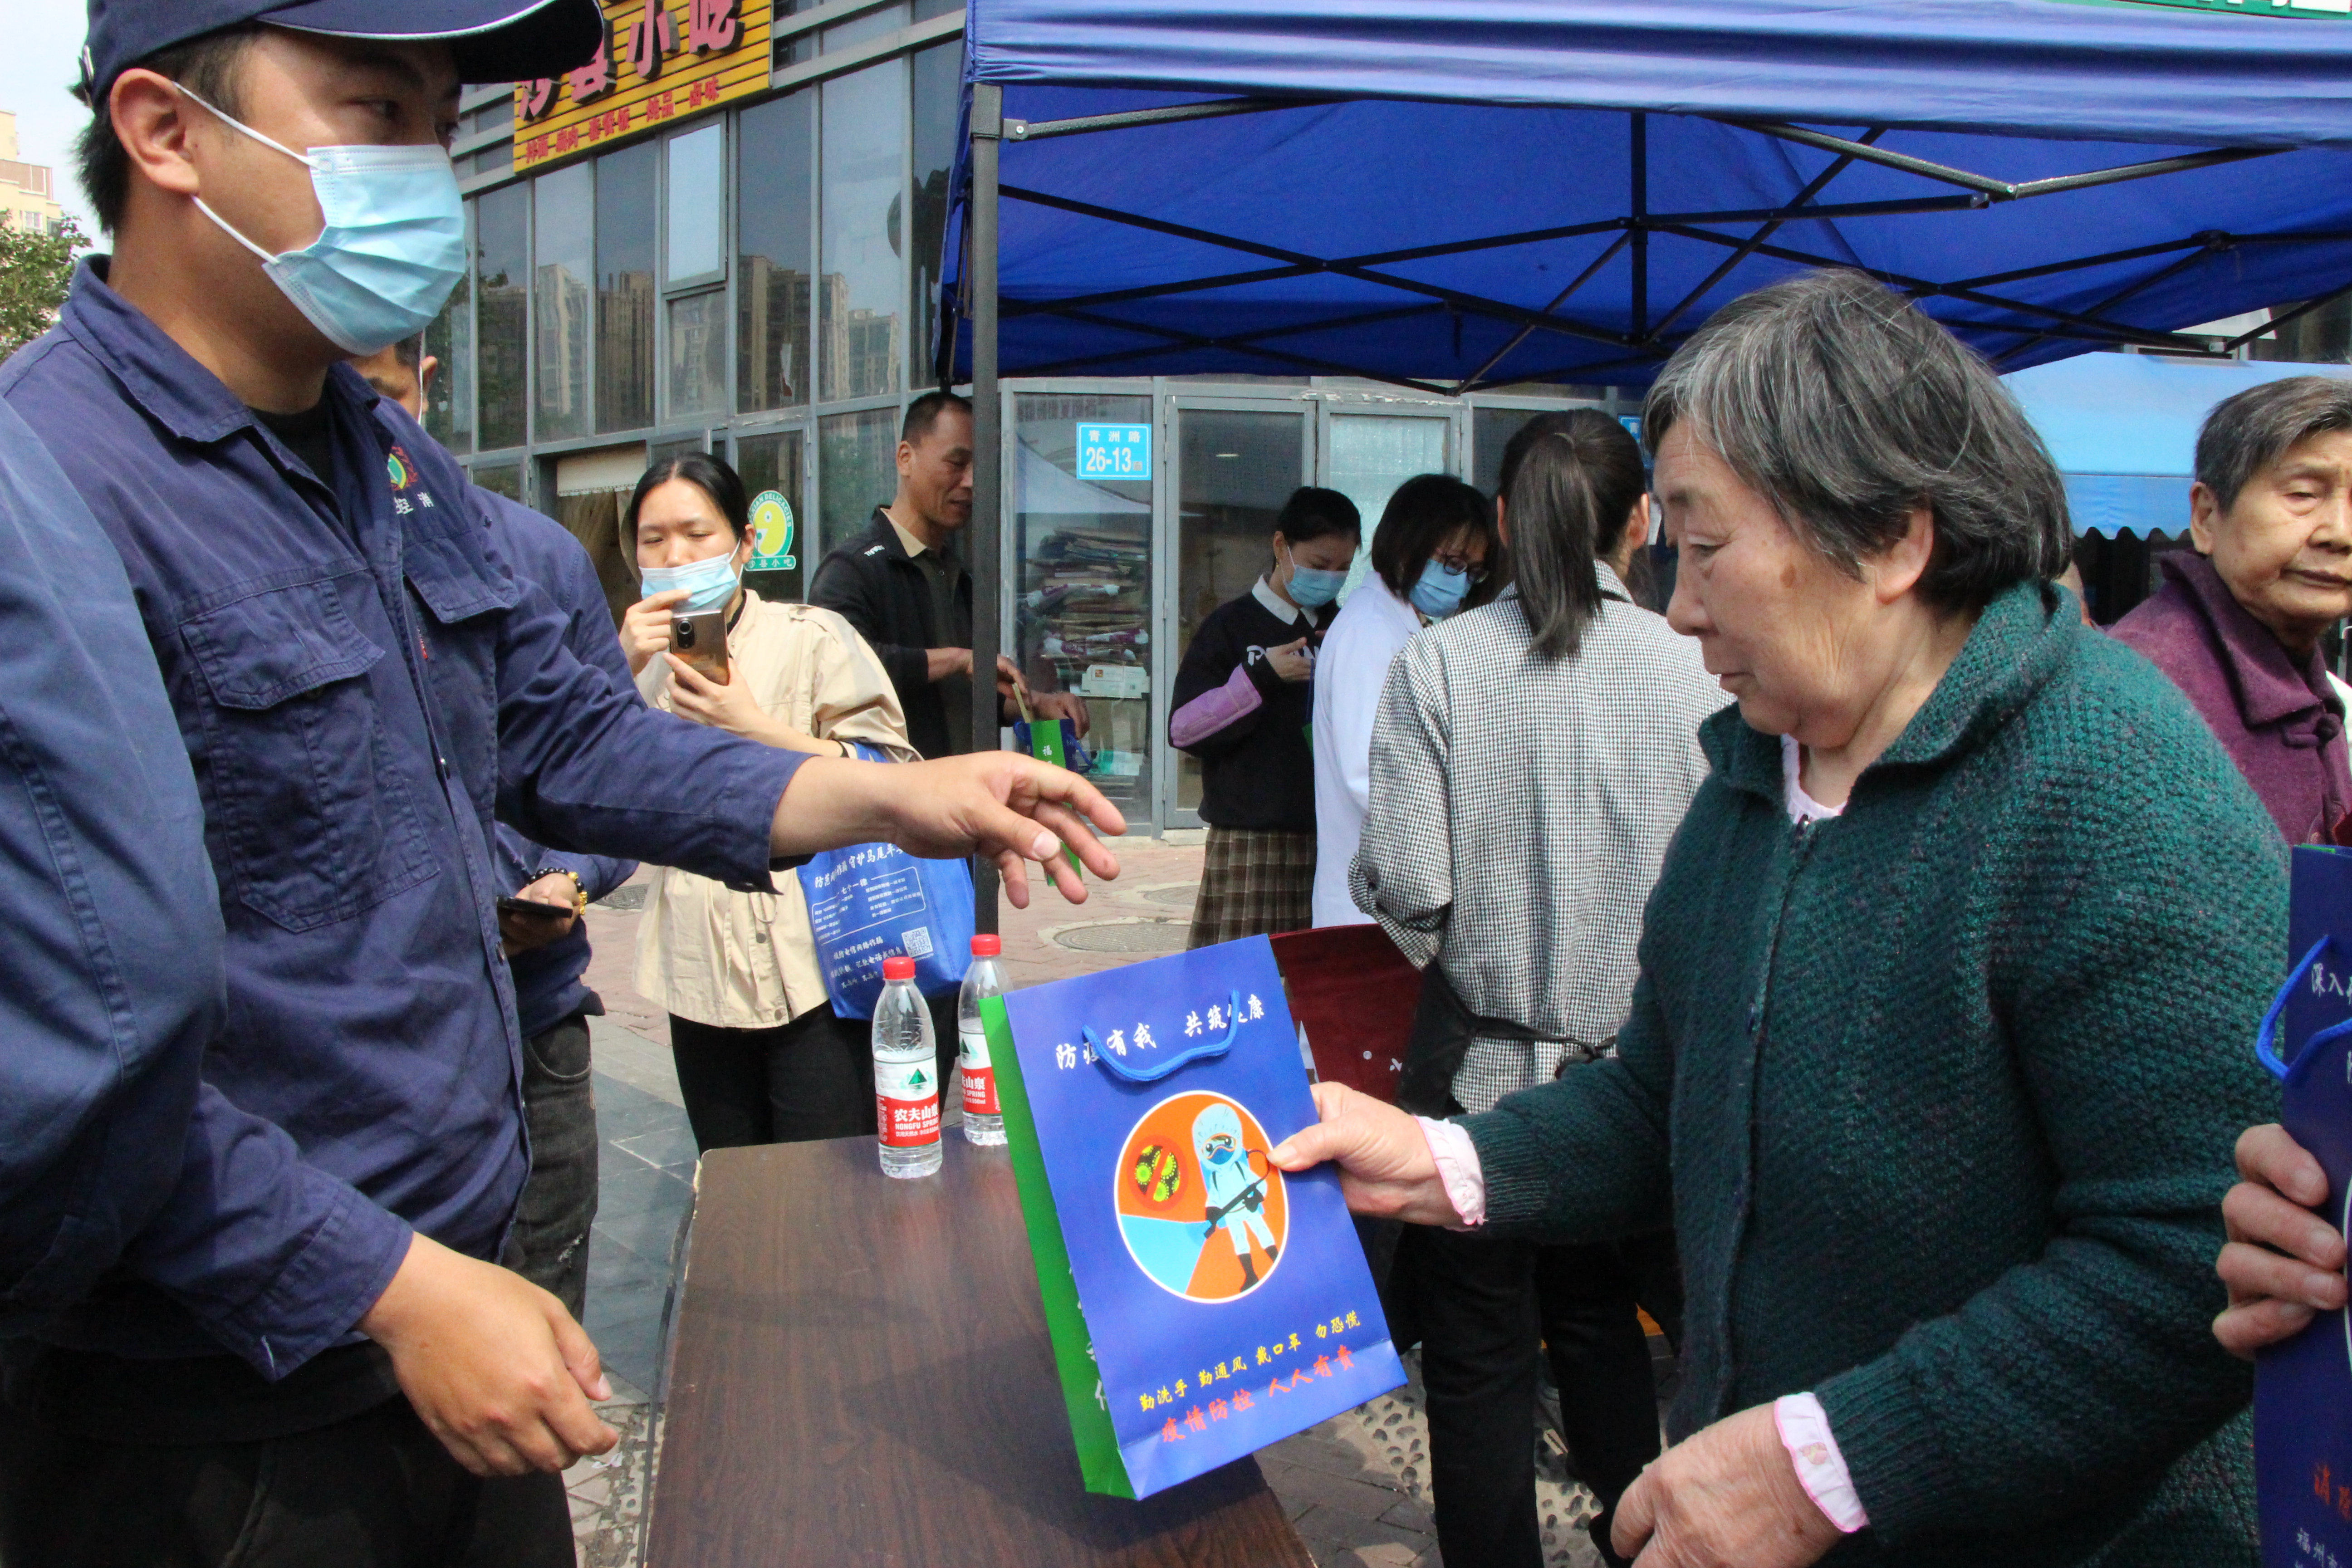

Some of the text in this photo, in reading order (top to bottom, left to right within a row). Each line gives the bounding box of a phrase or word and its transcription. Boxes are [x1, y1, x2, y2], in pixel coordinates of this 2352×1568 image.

[1088, 430, 1140, 443] 青洲路
[1086, 446, 1132, 472] 26-13
[894, 1102, 938, 1122] 农夫山泉
[895, 1117, 939, 1130] NONGFU SPRING
[1139, 1310, 1360, 1412] 勤洗手 勤通风 戴口罩 勿恐慌
[1161, 1344, 1354, 1442] 疫情防控 人人有责
